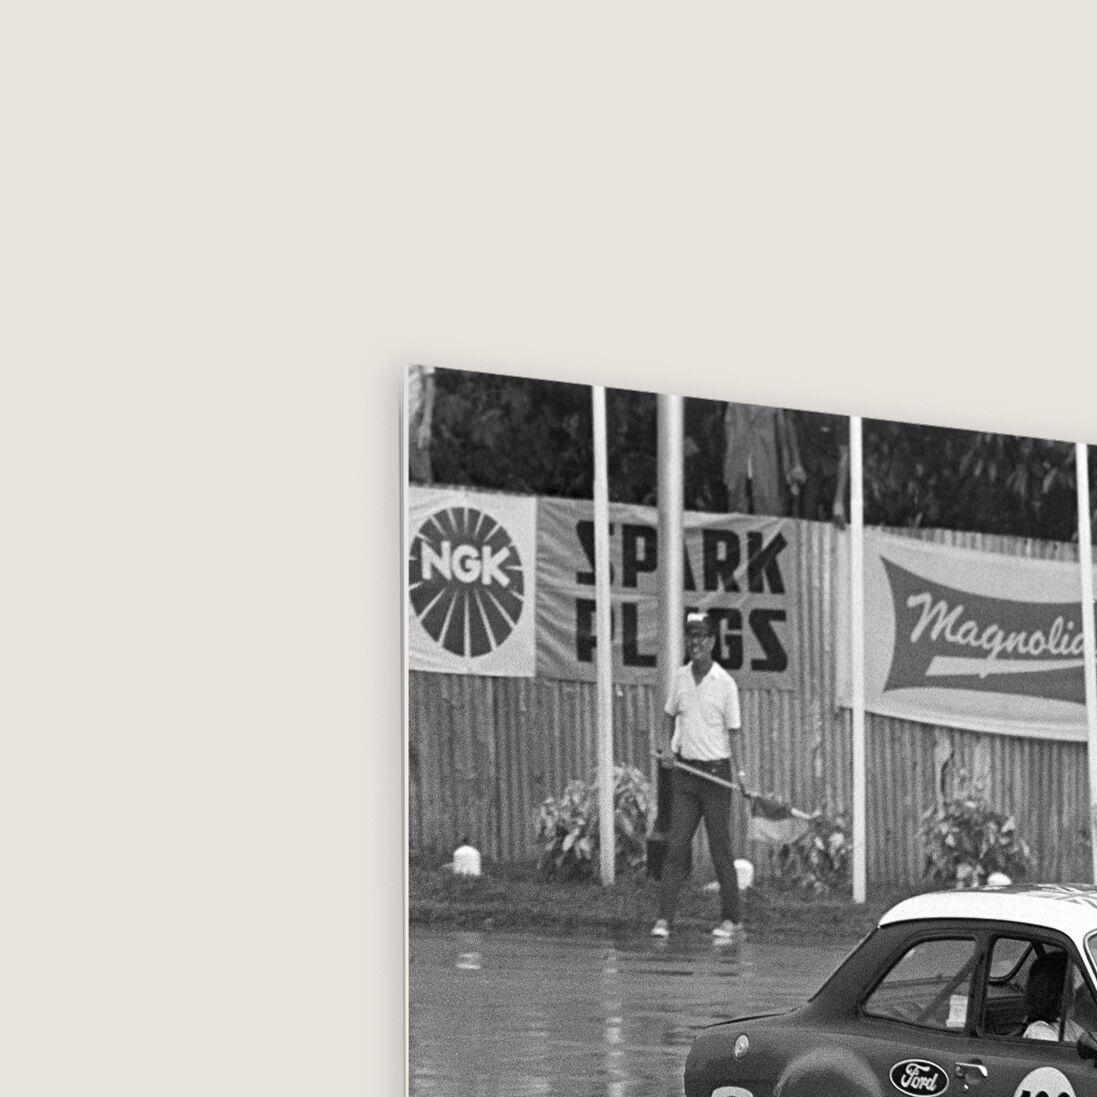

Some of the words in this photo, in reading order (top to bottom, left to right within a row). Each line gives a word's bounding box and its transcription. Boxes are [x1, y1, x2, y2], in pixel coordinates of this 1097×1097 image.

[420, 540, 511, 588] NGK
[576, 519, 788, 594] SPRK
[576, 598, 788, 672] PLGS
[901, 1062, 939, 1092] Ford
